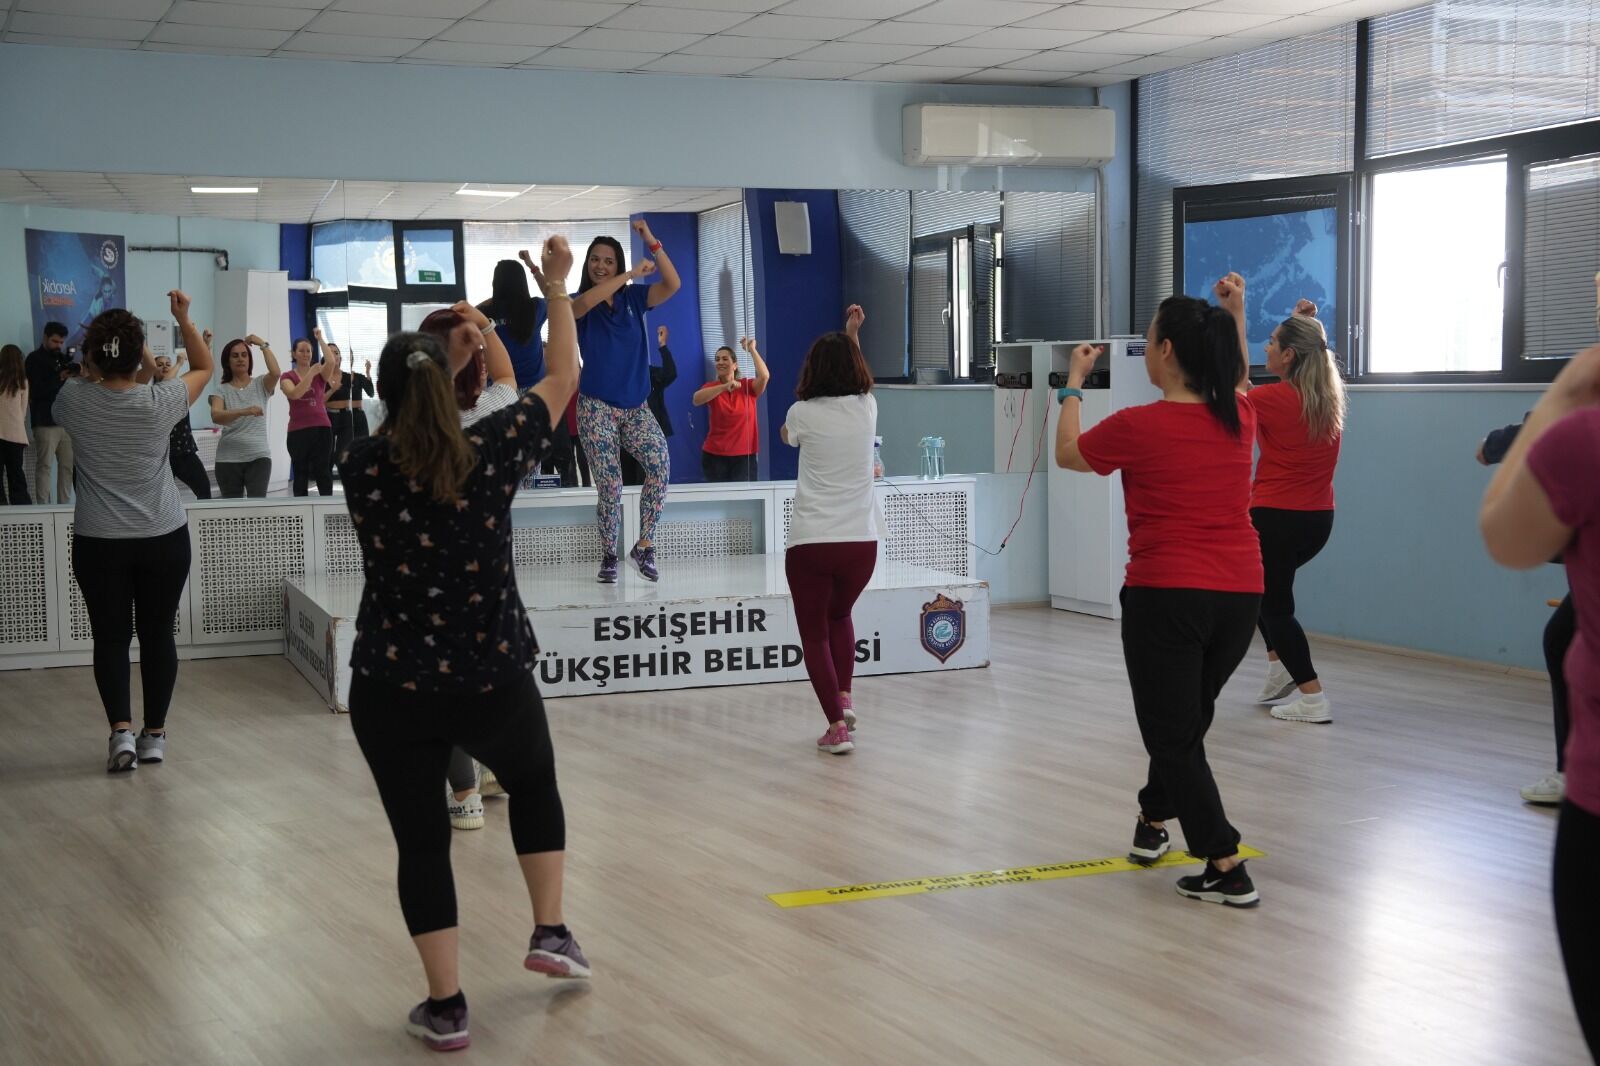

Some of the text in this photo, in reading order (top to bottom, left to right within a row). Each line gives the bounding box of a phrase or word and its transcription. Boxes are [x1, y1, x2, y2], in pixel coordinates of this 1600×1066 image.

[594, 602, 767, 643] ESKİŞEHİR
[530, 632, 881, 687] ÜKŞEHİR BELEDSİ
